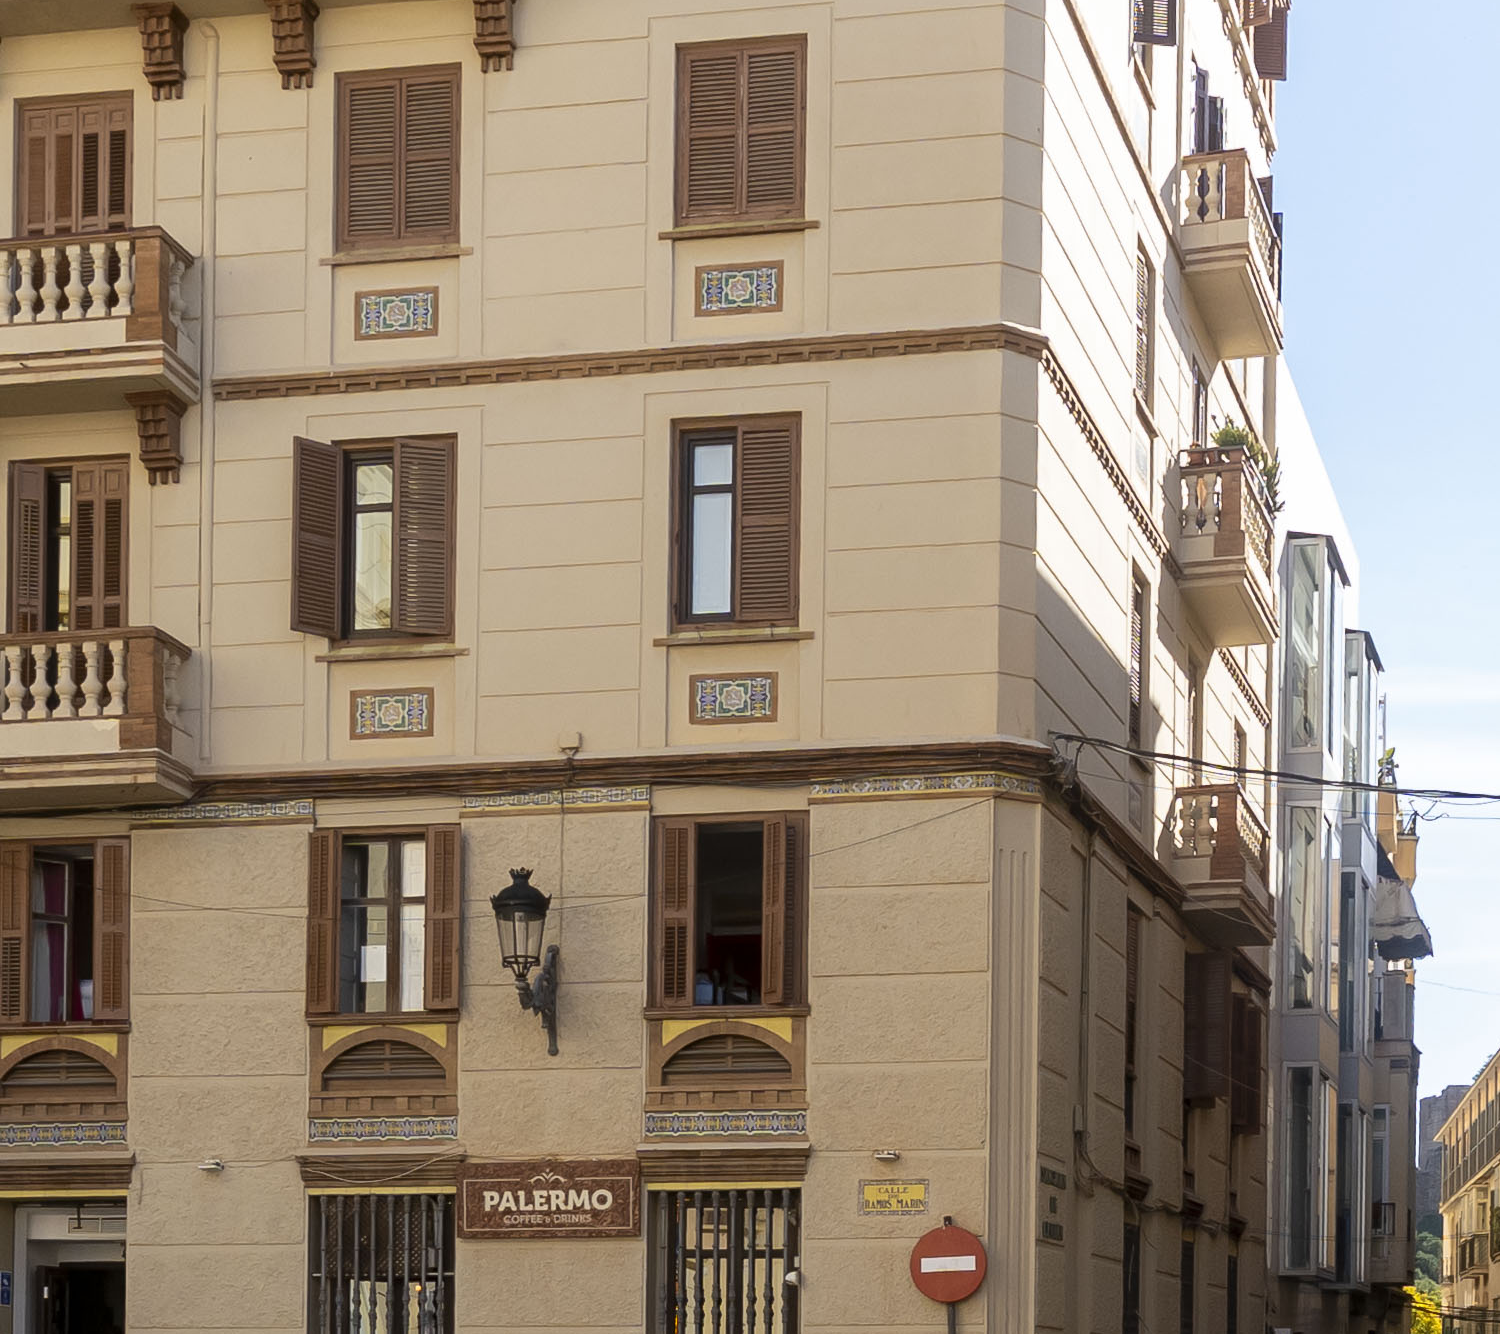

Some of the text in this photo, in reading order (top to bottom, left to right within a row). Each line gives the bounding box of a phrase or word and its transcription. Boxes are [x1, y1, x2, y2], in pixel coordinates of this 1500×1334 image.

[483, 1189, 613, 1212] PALERMO
[504, 1214, 543, 1224] COFFEE
[553, 1214, 592, 1223] DRINKS
